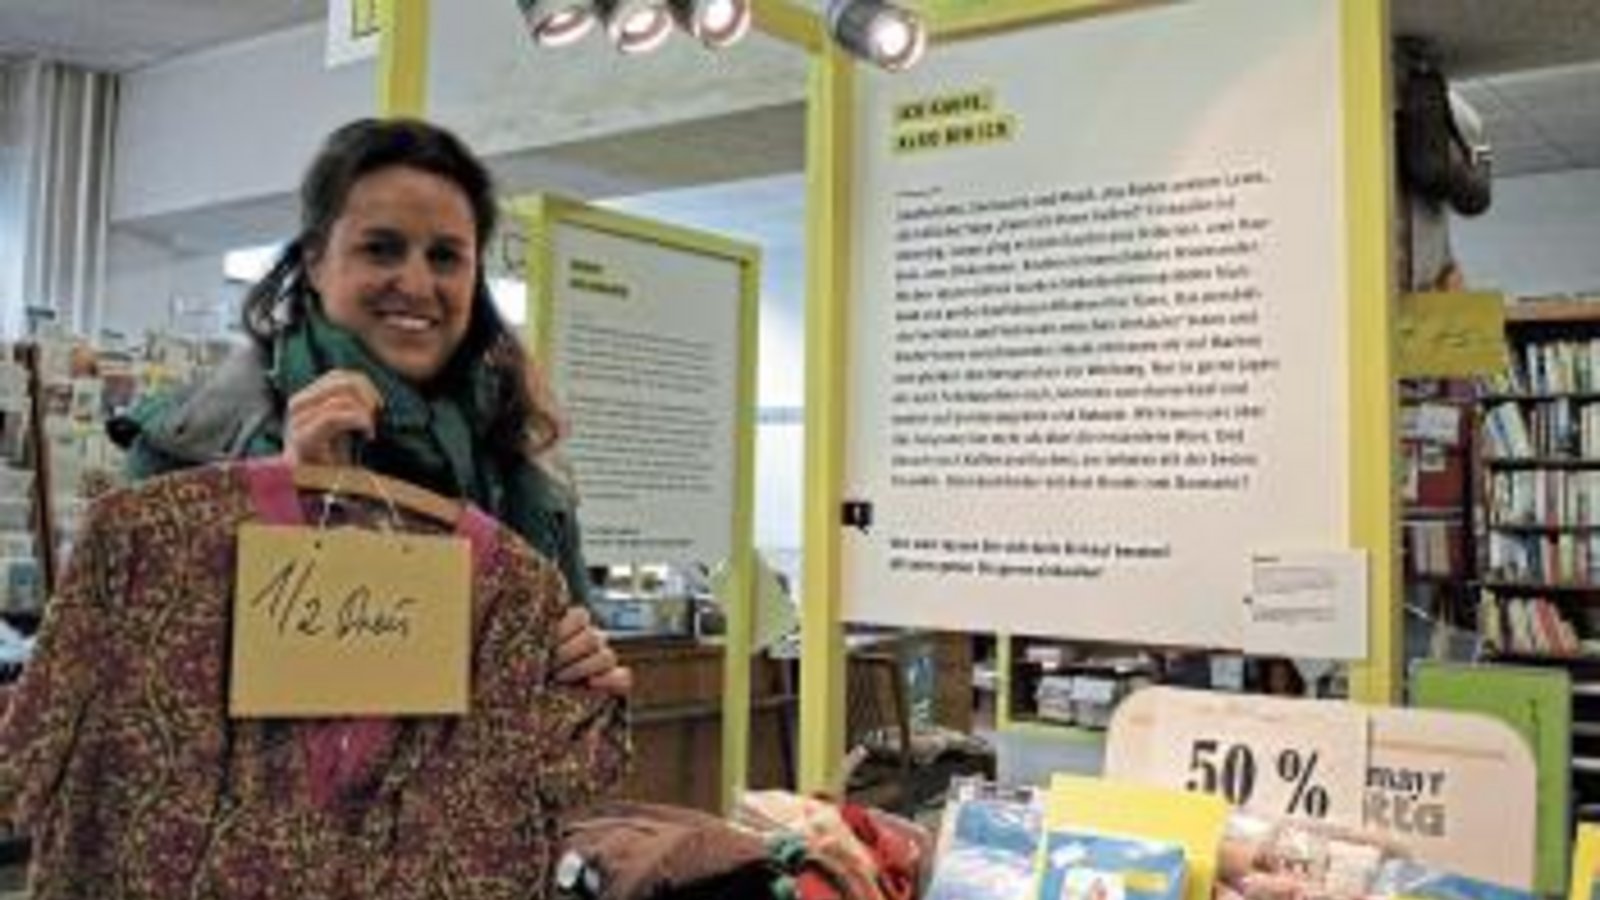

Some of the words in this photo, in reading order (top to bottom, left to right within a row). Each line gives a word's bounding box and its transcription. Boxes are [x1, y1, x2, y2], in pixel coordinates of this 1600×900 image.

[251, 559, 325, 637] 1/2
[1186, 739, 1256, 806] 50
[1277, 749, 1329, 818] %
